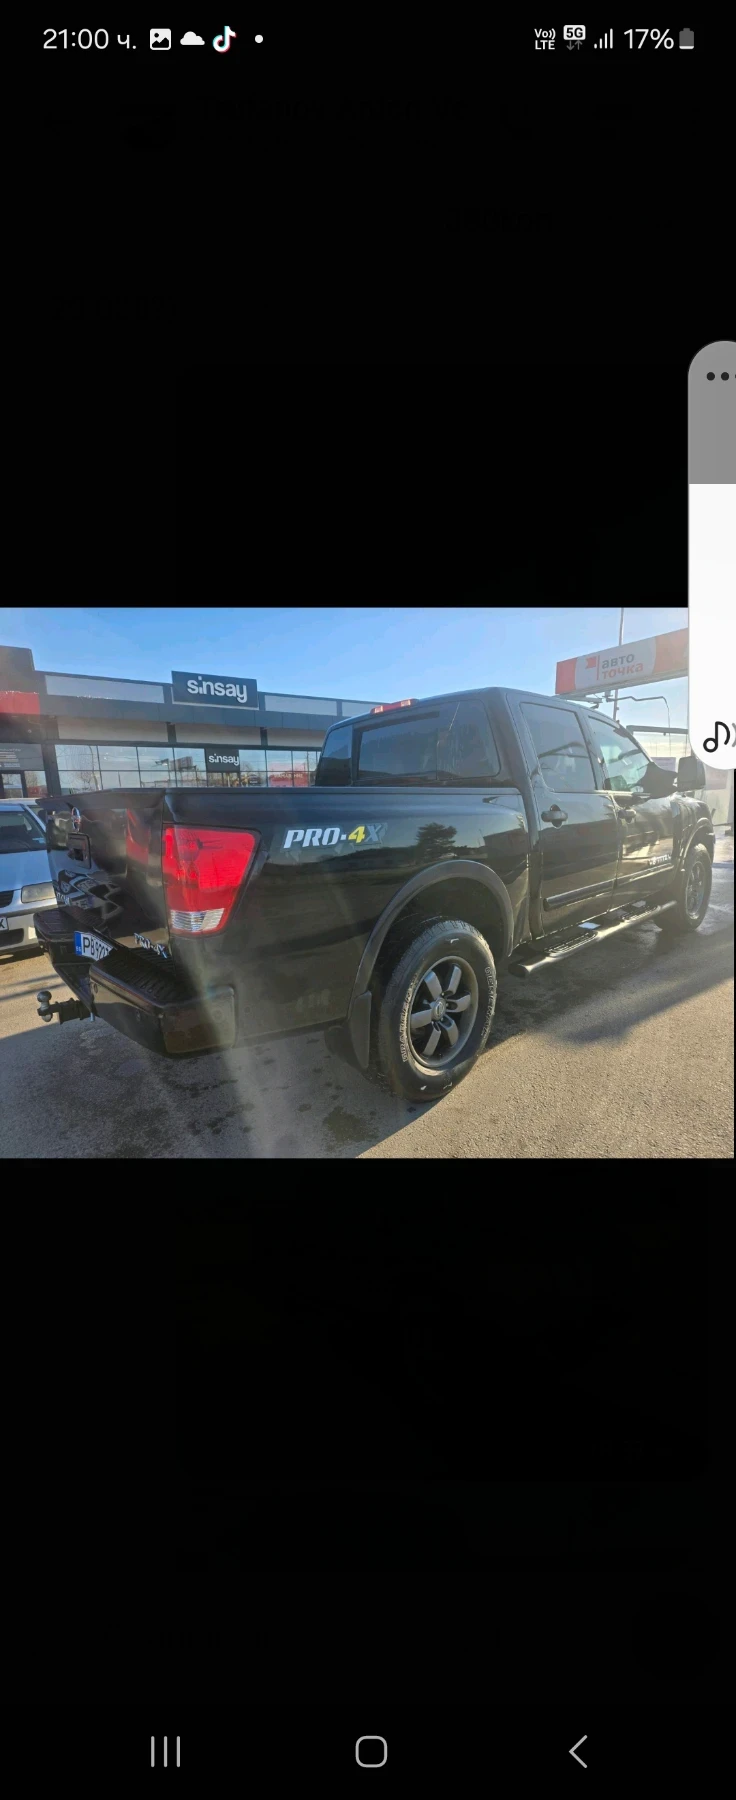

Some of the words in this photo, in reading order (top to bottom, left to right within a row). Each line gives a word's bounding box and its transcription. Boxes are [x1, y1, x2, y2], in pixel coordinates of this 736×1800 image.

[43, 28, 109, 49] 21:00
[117, 34, 136, 49] ч.
[566, 27, 584, 38] 5G
[624, 28, 674, 49] 17%
[534, 40, 555, 50] LTE
[602, 654, 635, 669] авто
[602, 662, 644, 679] точка
[187, 676, 248, 704] sinsay
[208, 753, 240, 766] sinsay
